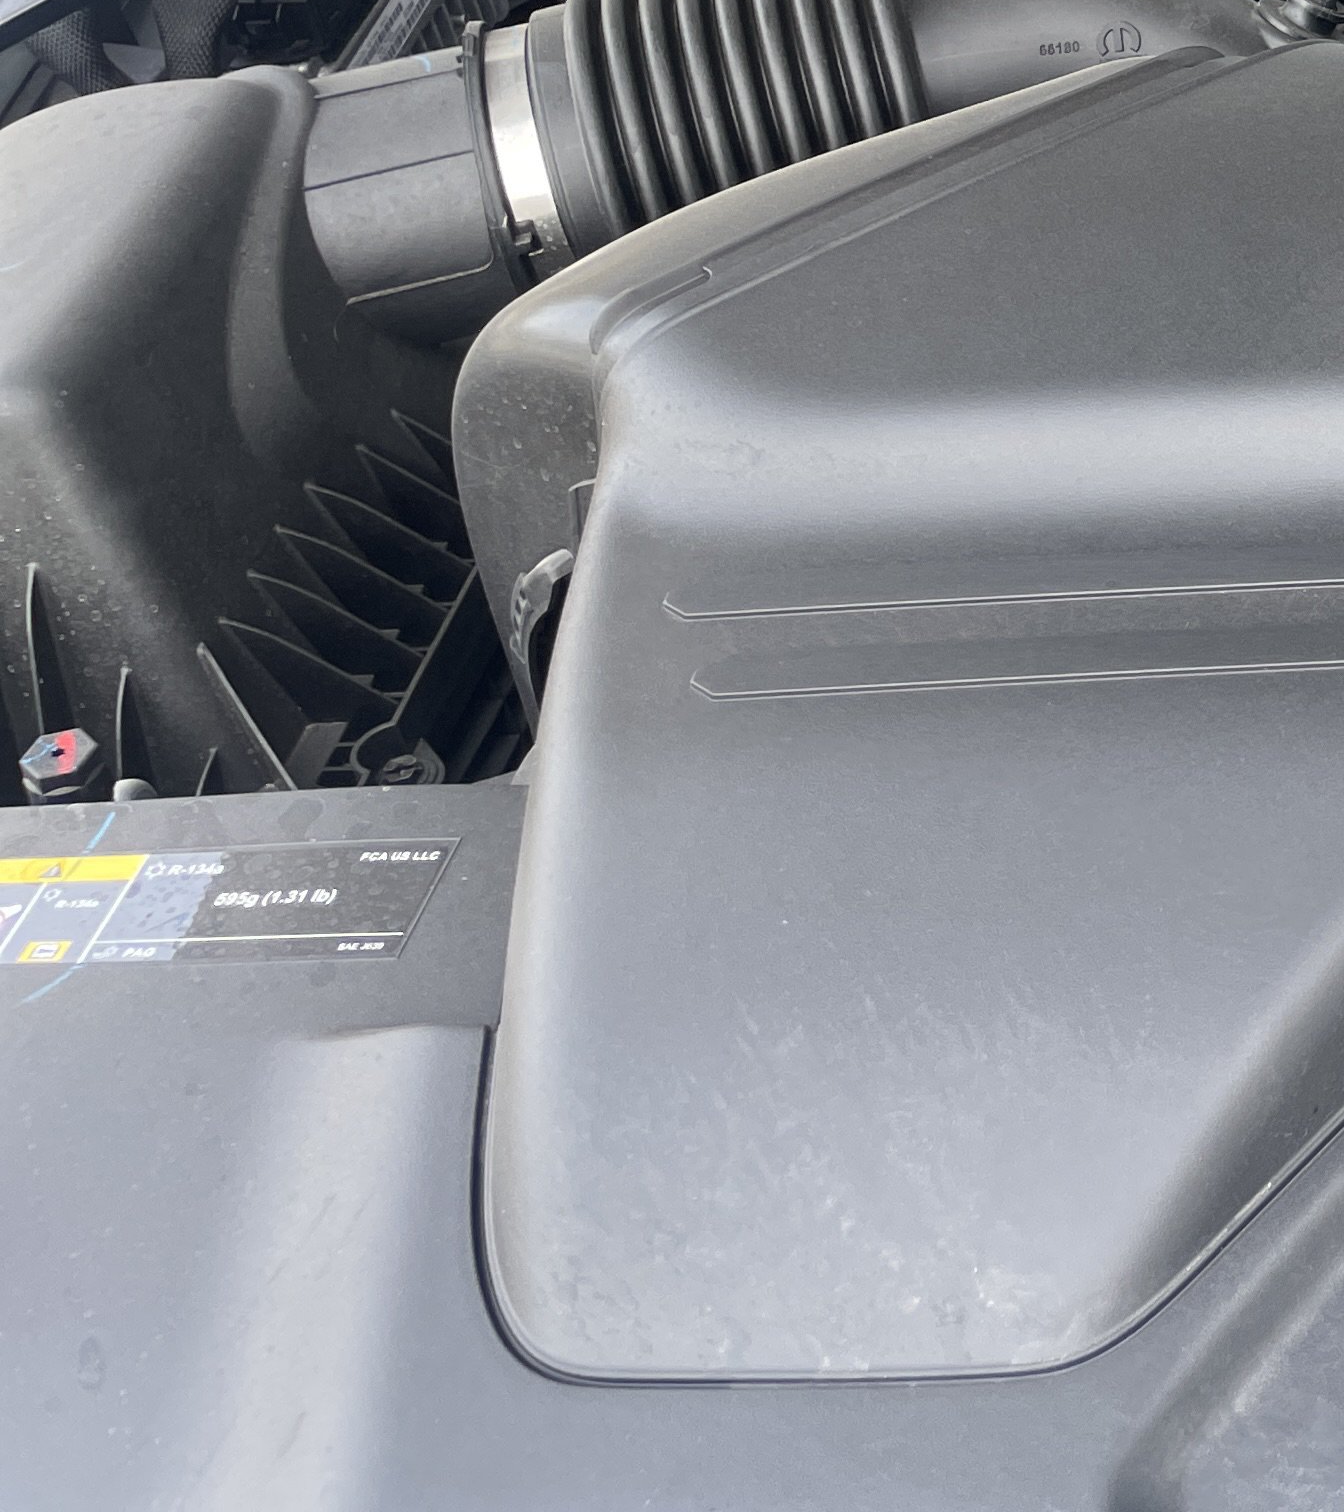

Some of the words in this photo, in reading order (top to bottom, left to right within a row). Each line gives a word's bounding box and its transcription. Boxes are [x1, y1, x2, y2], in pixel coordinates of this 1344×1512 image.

[359, 852, 388, 862] FCA
[390, 851, 411, 861] US
[412, 850, 442, 861] LLC
[167, 864, 225, 876] R-134a
[213, 891, 260, 909] 595g
[261, 889, 309, 907] (1.31
[310, 888, 339, 905] lb)
[122, 947, 157, 958] PAG
[337, 942, 361, 951] SAE
